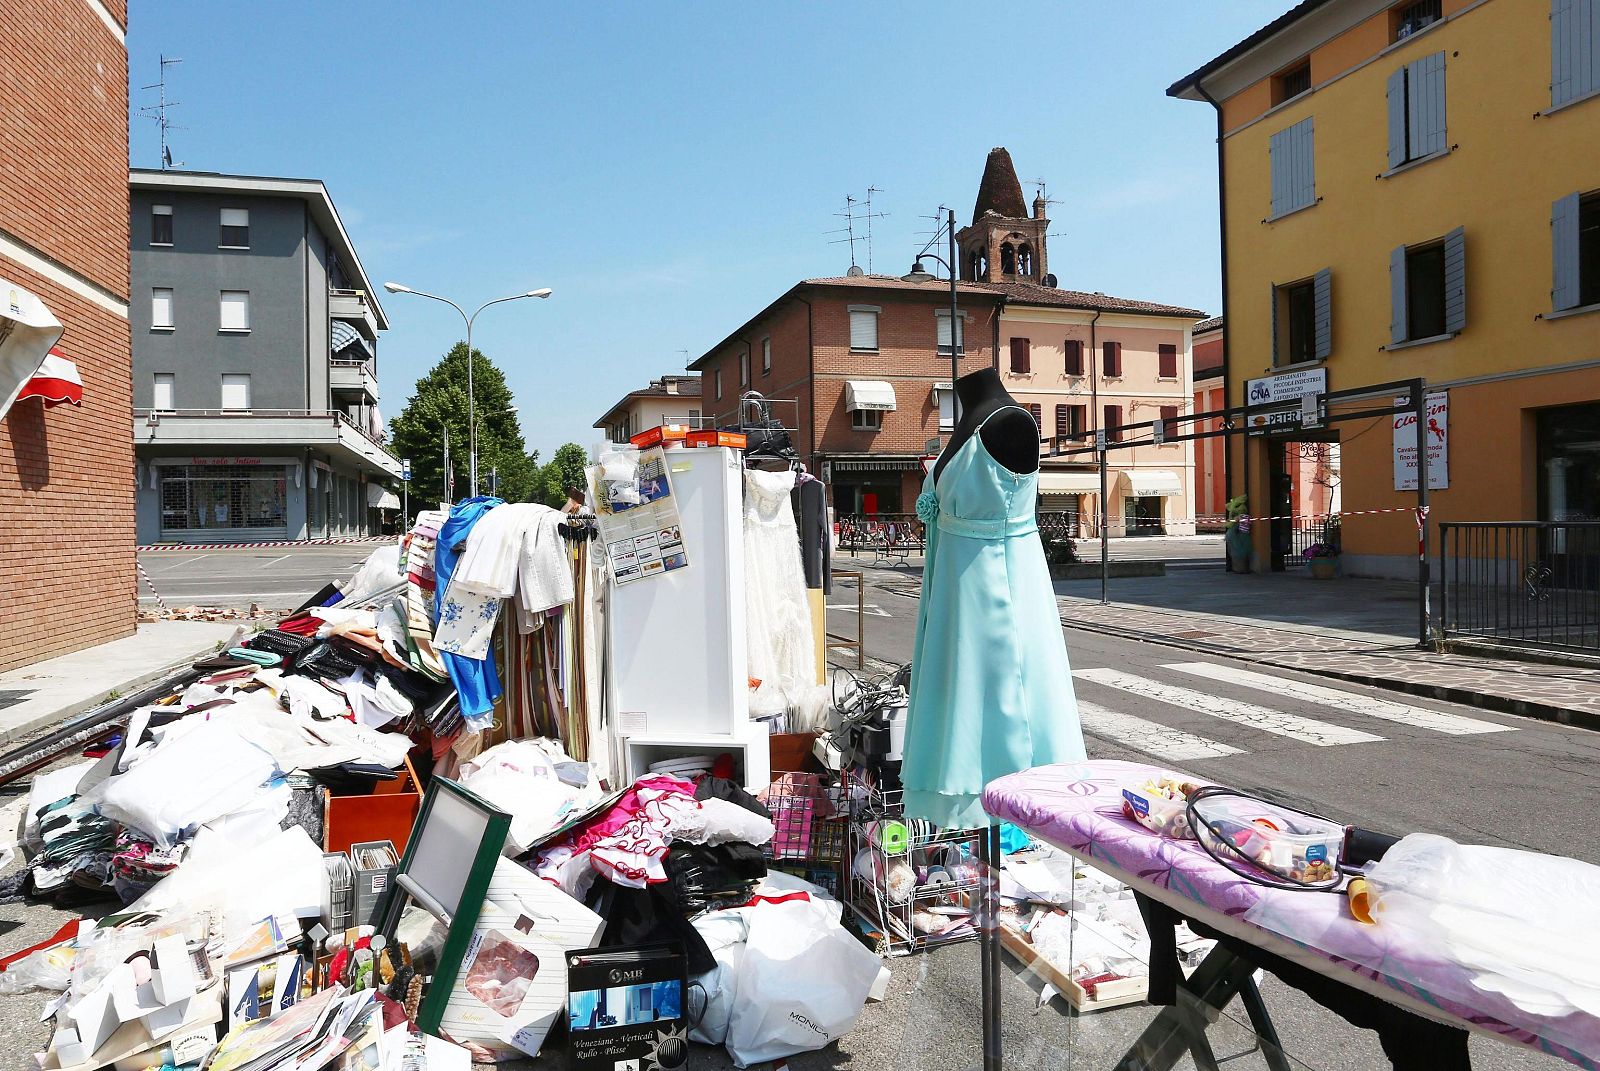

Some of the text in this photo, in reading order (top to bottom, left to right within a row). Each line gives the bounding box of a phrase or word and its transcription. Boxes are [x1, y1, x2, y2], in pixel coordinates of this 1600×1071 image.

[1274, 372, 1307, 381] ARTIGIANATO
[1273, 377, 1321, 388] PICCOLA INDUSTRIA
[1251, 387, 1270, 401] CNA
[1273, 386, 1304, 395] COMMERCIO
[1269, 411, 1298, 424] PETER
[191, 456, 207, 465] Non
[235, 456, 262, 465] Intimo
[789, 1011, 829, 1039] MONICA
[573, 1037, 614, 1049] Veneziane
[621, 1031, 654, 1044] Verticali
[576, 1049, 598, 1060] Rullo
